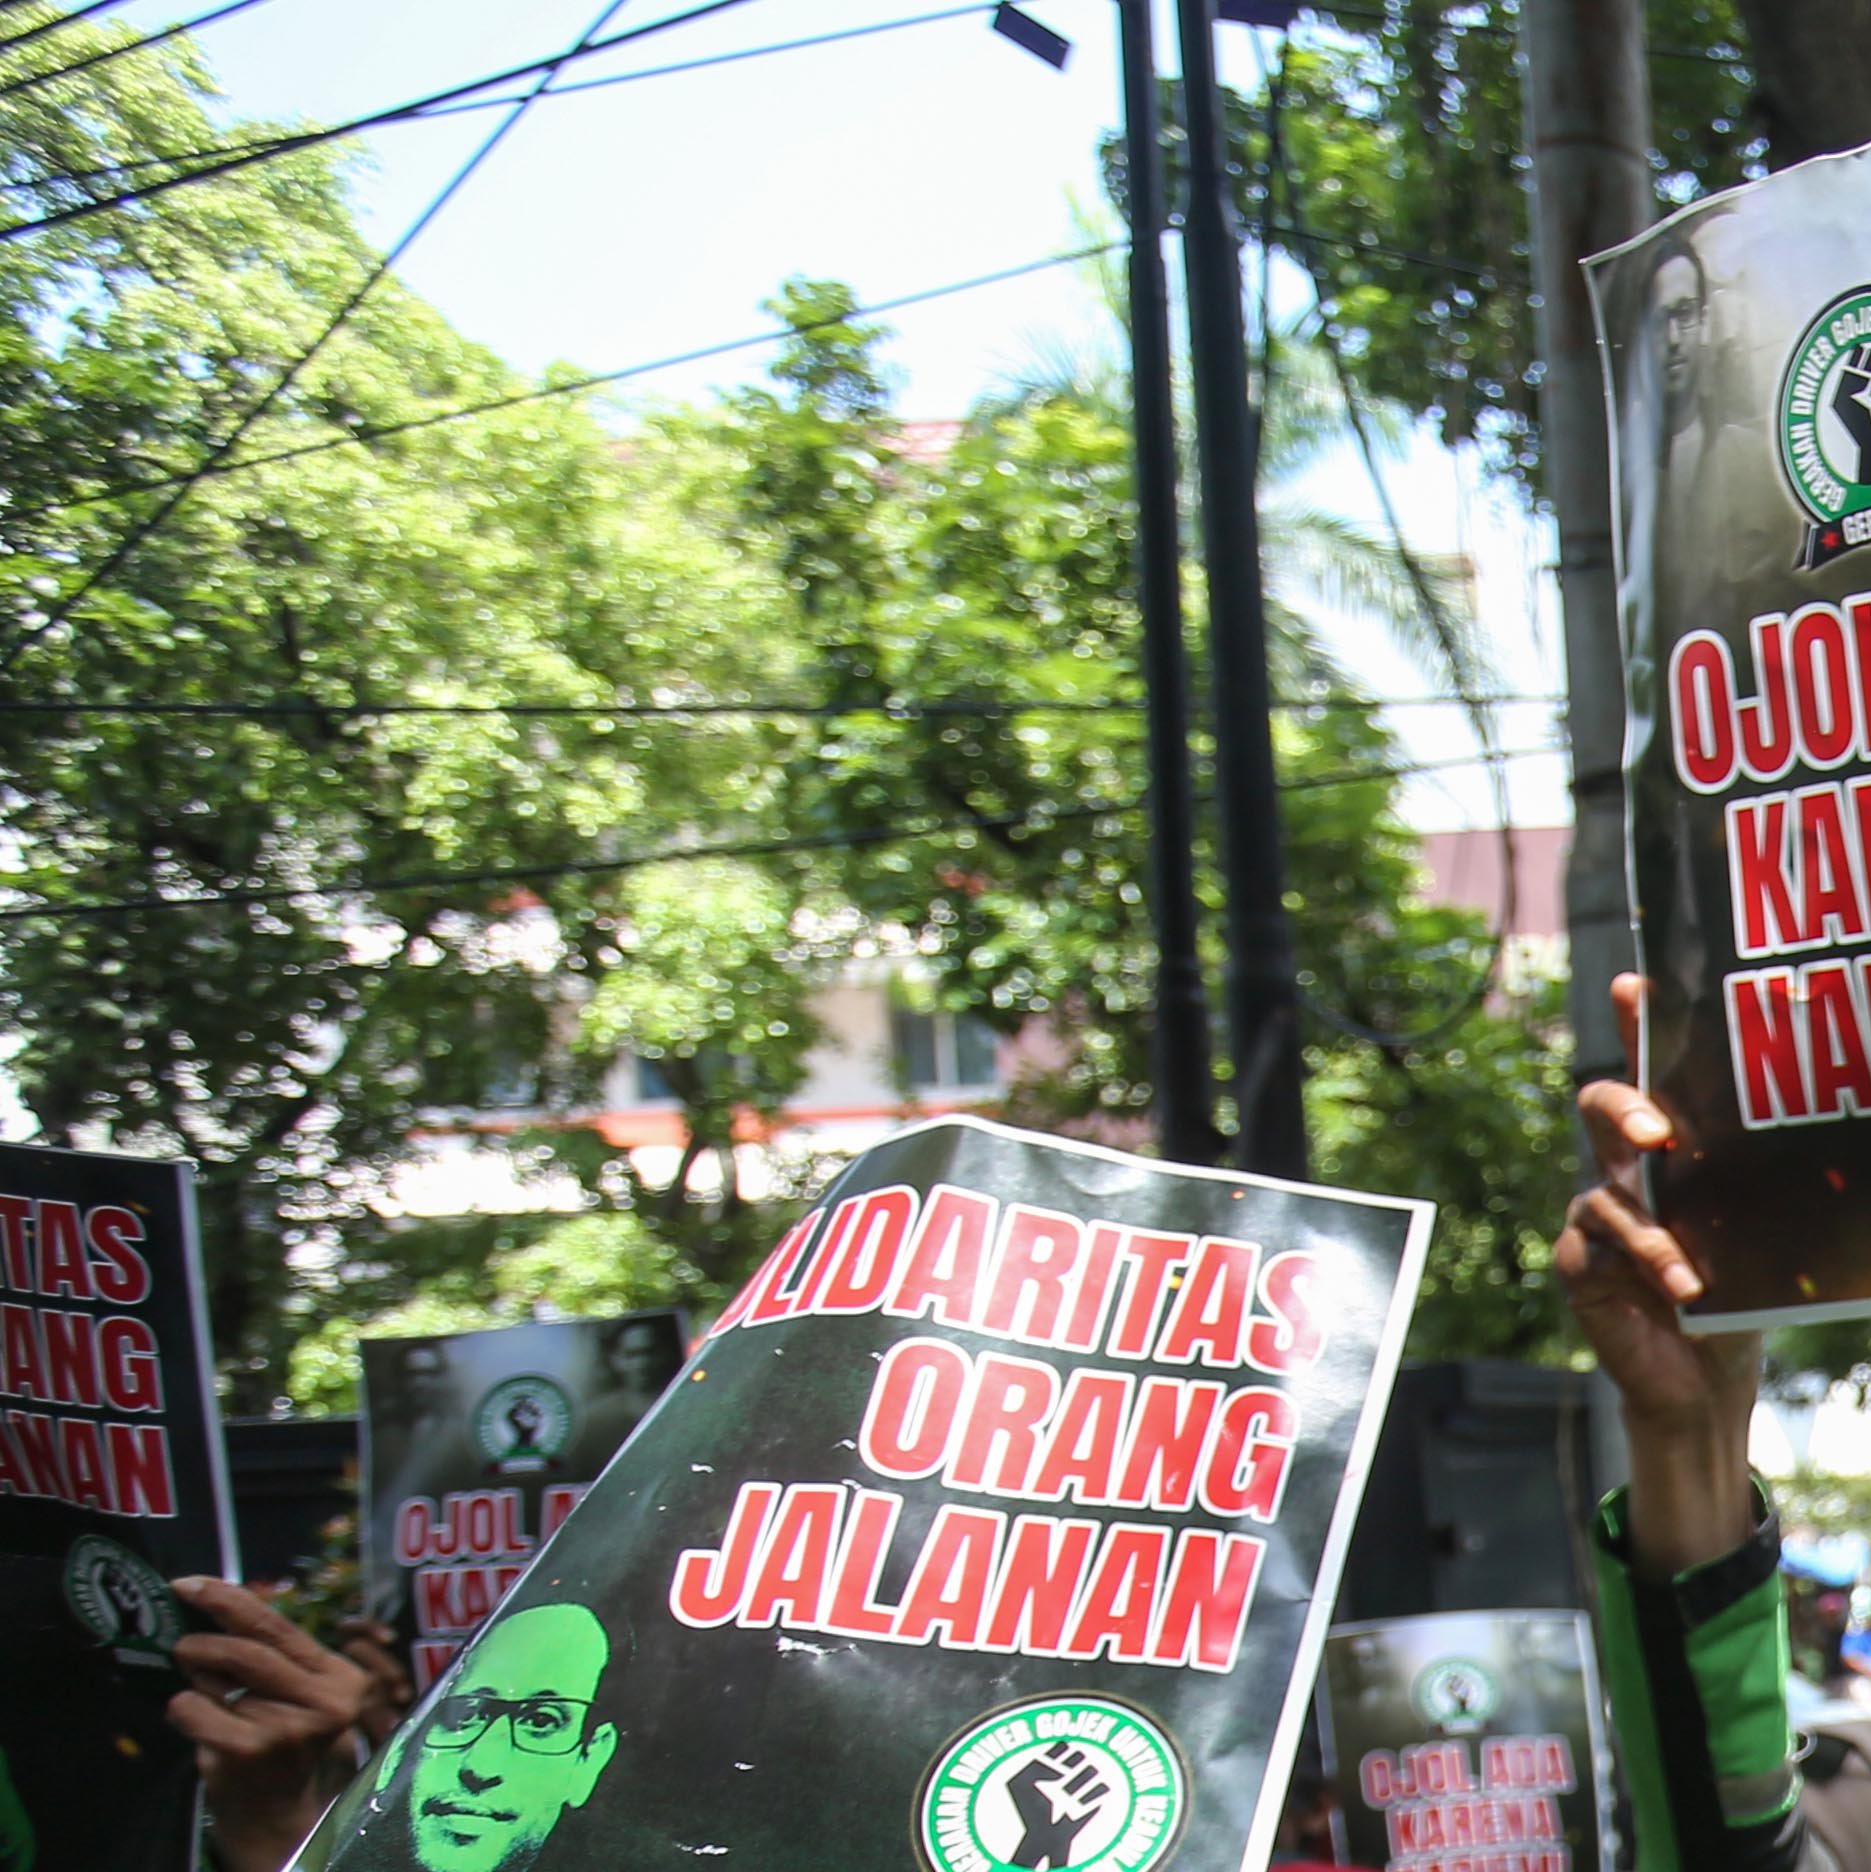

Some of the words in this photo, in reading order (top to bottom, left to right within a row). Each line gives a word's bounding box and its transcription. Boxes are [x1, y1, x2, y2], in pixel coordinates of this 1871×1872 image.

[1790, 335, 1838, 415] DRIVER
[706, 1183, 1326, 1375] LIDARITAS
[859, 1338, 1303, 1524] ORANG
[393, 1487, 537, 1566] OJOL
[667, 1481, 1266, 1673] JALANAN
[1035, 1710, 1119, 1744] GOJEK
[1360, 1738, 1481, 1810] OJOL
[1481, 1735, 1577, 1794] ADA
[1385, 1796, 1563, 1858] KARENA
